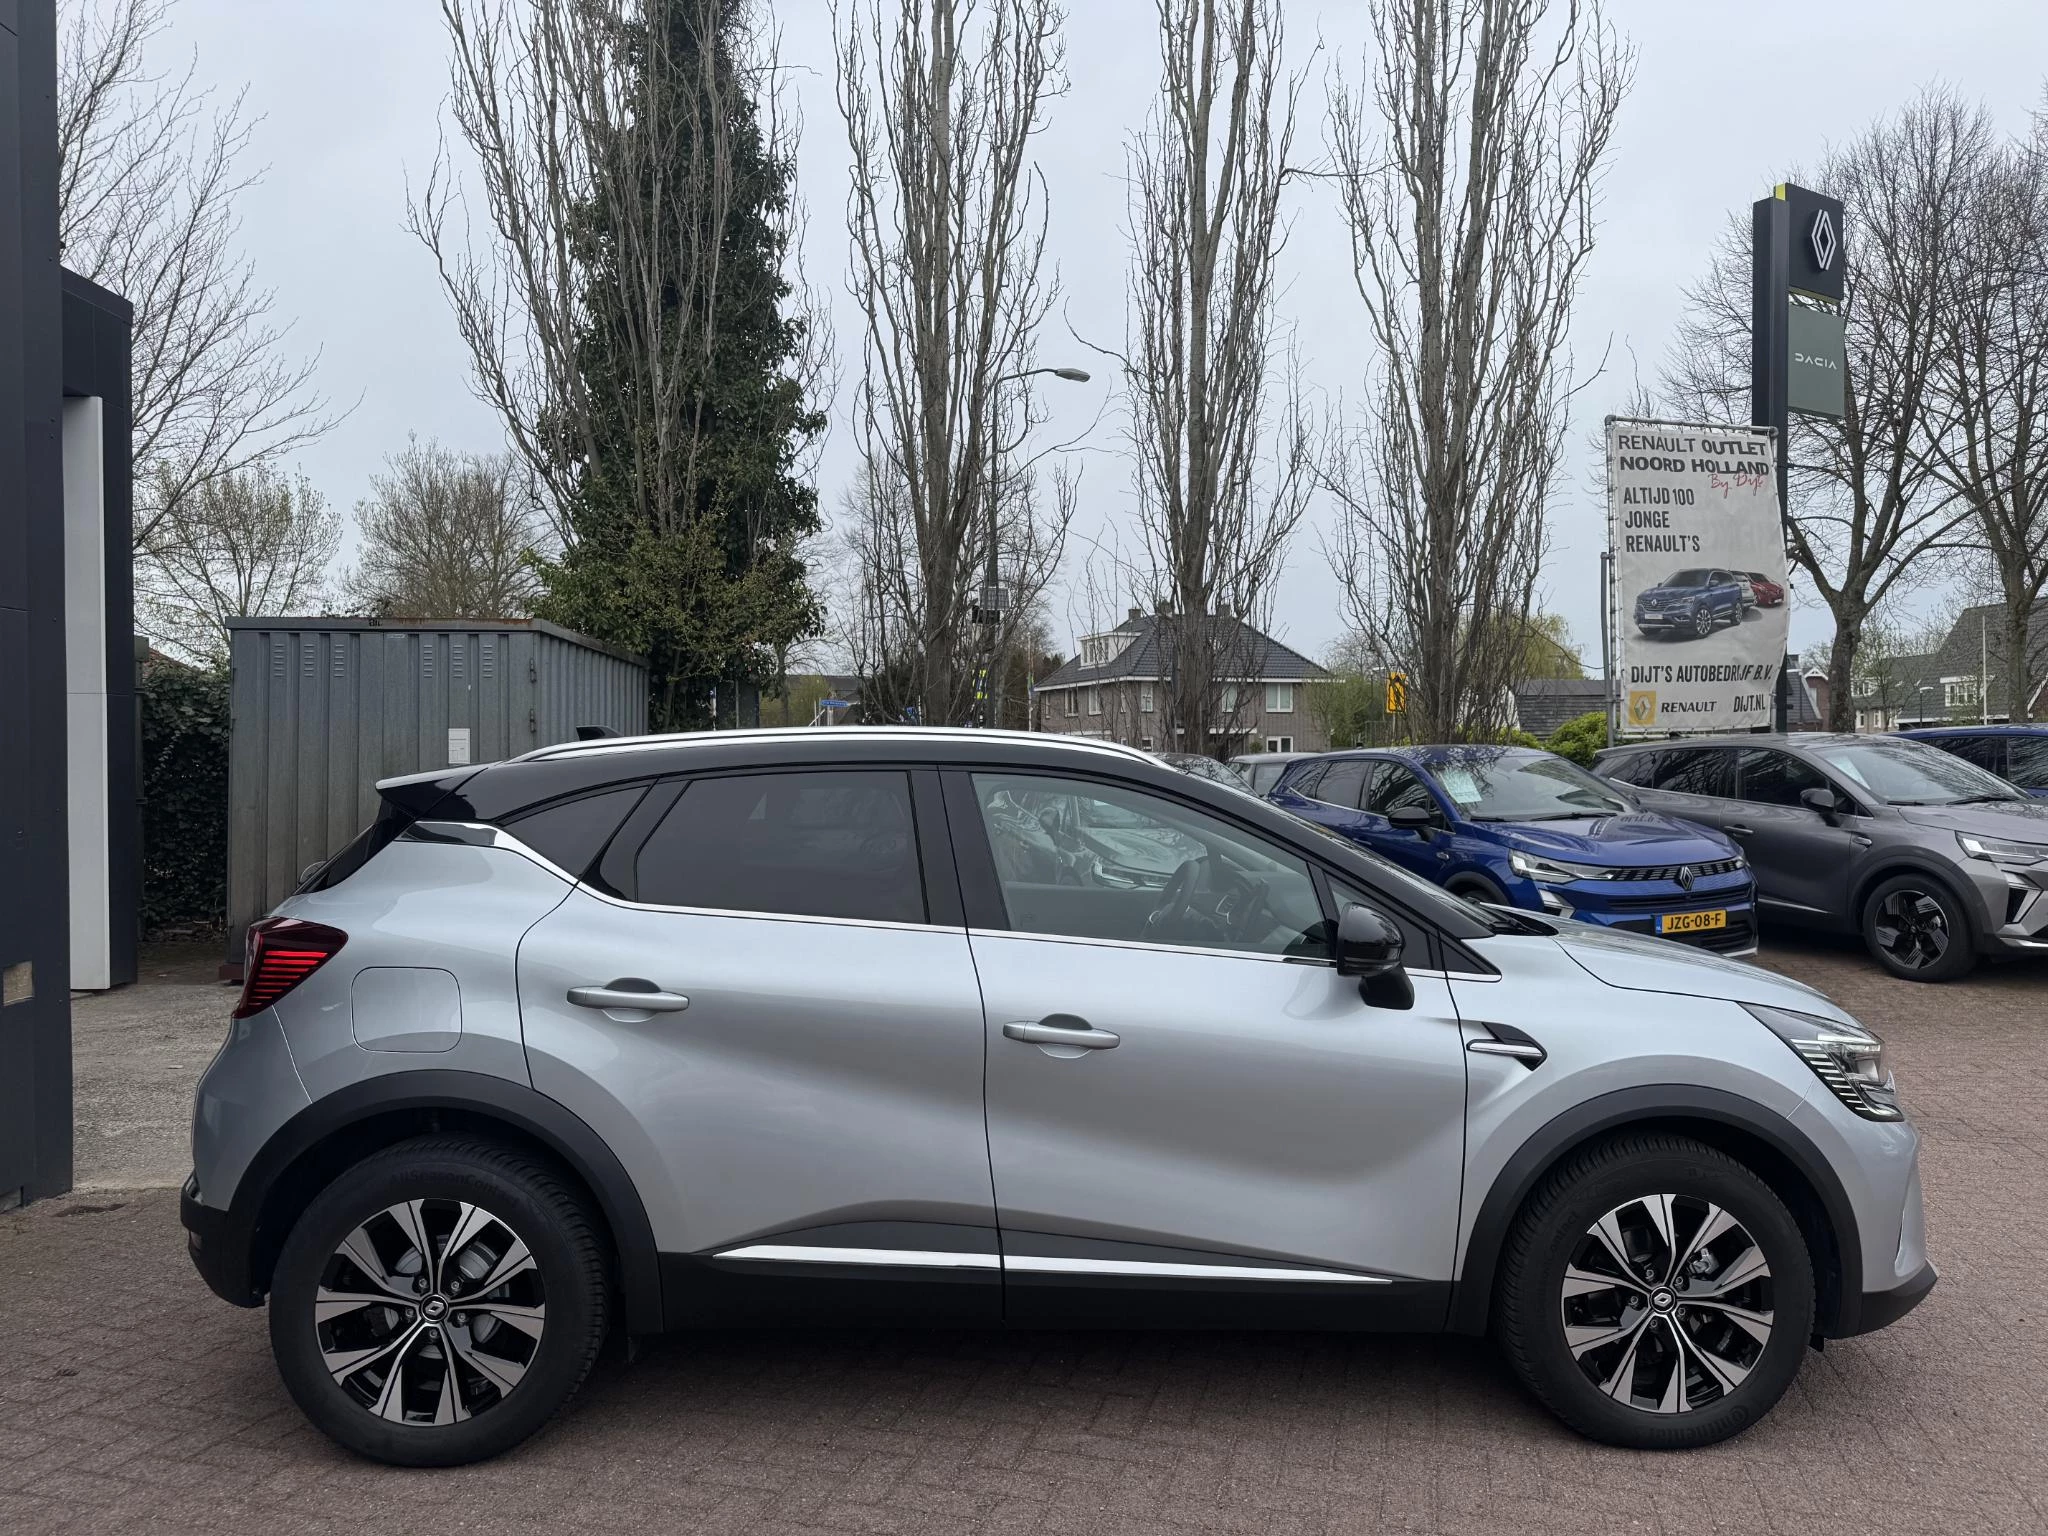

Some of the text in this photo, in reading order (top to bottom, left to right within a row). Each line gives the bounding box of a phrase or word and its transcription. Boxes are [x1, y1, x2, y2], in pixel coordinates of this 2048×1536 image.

[1794, 352, 1838, 370] DACIA
[1618, 435, 1767, 456] RENAULT OUTLET
[1620, 456, 1770, 475] NOORD HOLLAND
[1623, 487, 1695, 506] ALTIJD 100
[1624, 510, 1671, 529] JONGE
[1625, 534, 1701, 553] RENAULT'S
[1630, 664, 1774, 684] DIJT'S AUTOBEDRIJF B.V.
[1660, 700, 1717, 713] RENAULT
[1733, 694, 1766, 713] DIJT.NL
[1668, 913, 1721, 930] JZG-08-F
